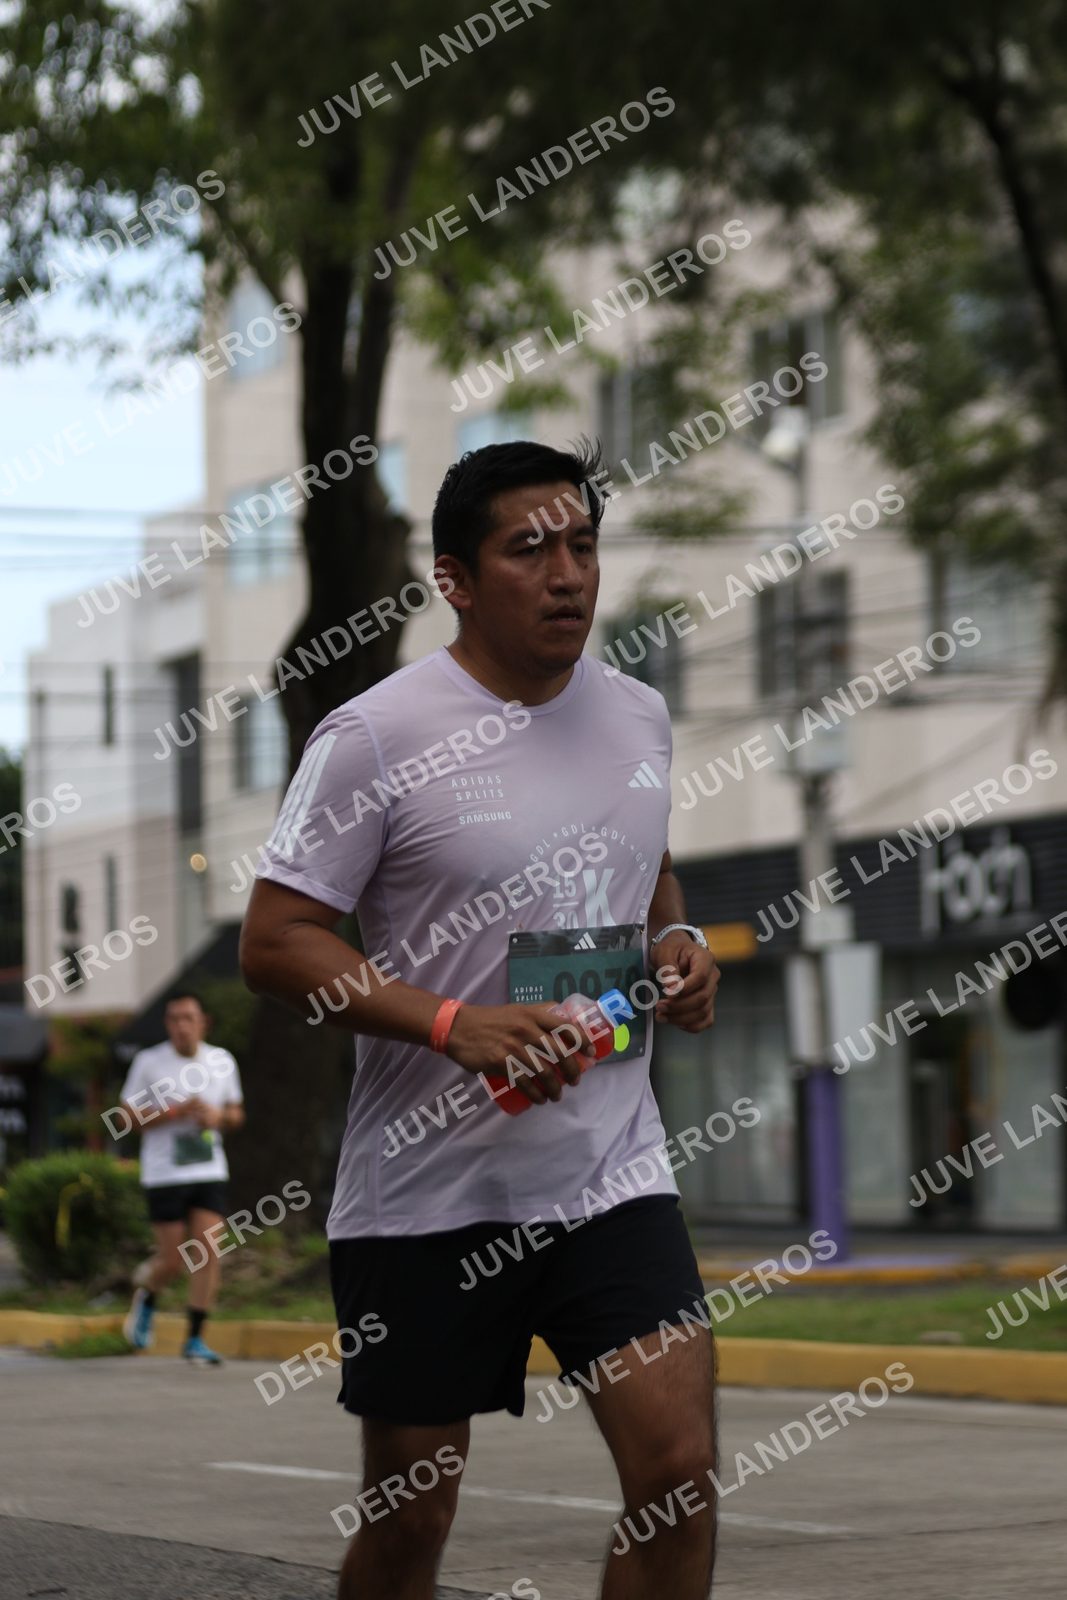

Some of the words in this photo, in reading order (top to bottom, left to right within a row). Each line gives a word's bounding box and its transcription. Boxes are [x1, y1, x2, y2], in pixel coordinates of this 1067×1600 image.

[451, 775, 501, 788] ADIDAS
[455, 789, 504, 801] SPLITS
[458, 811, 512, 825] SAMSUNG
[530, 839, 550, 863] GDL
[561, 823, 586, 837] GDL
[601, 827, 627, 846] GDL
[553, 872, 577, 899] 15
[582, 868, 616, 927] K
[514, 985, 543, 994] ADIDAS
[516, 994, 543, 1002] SPLITS
